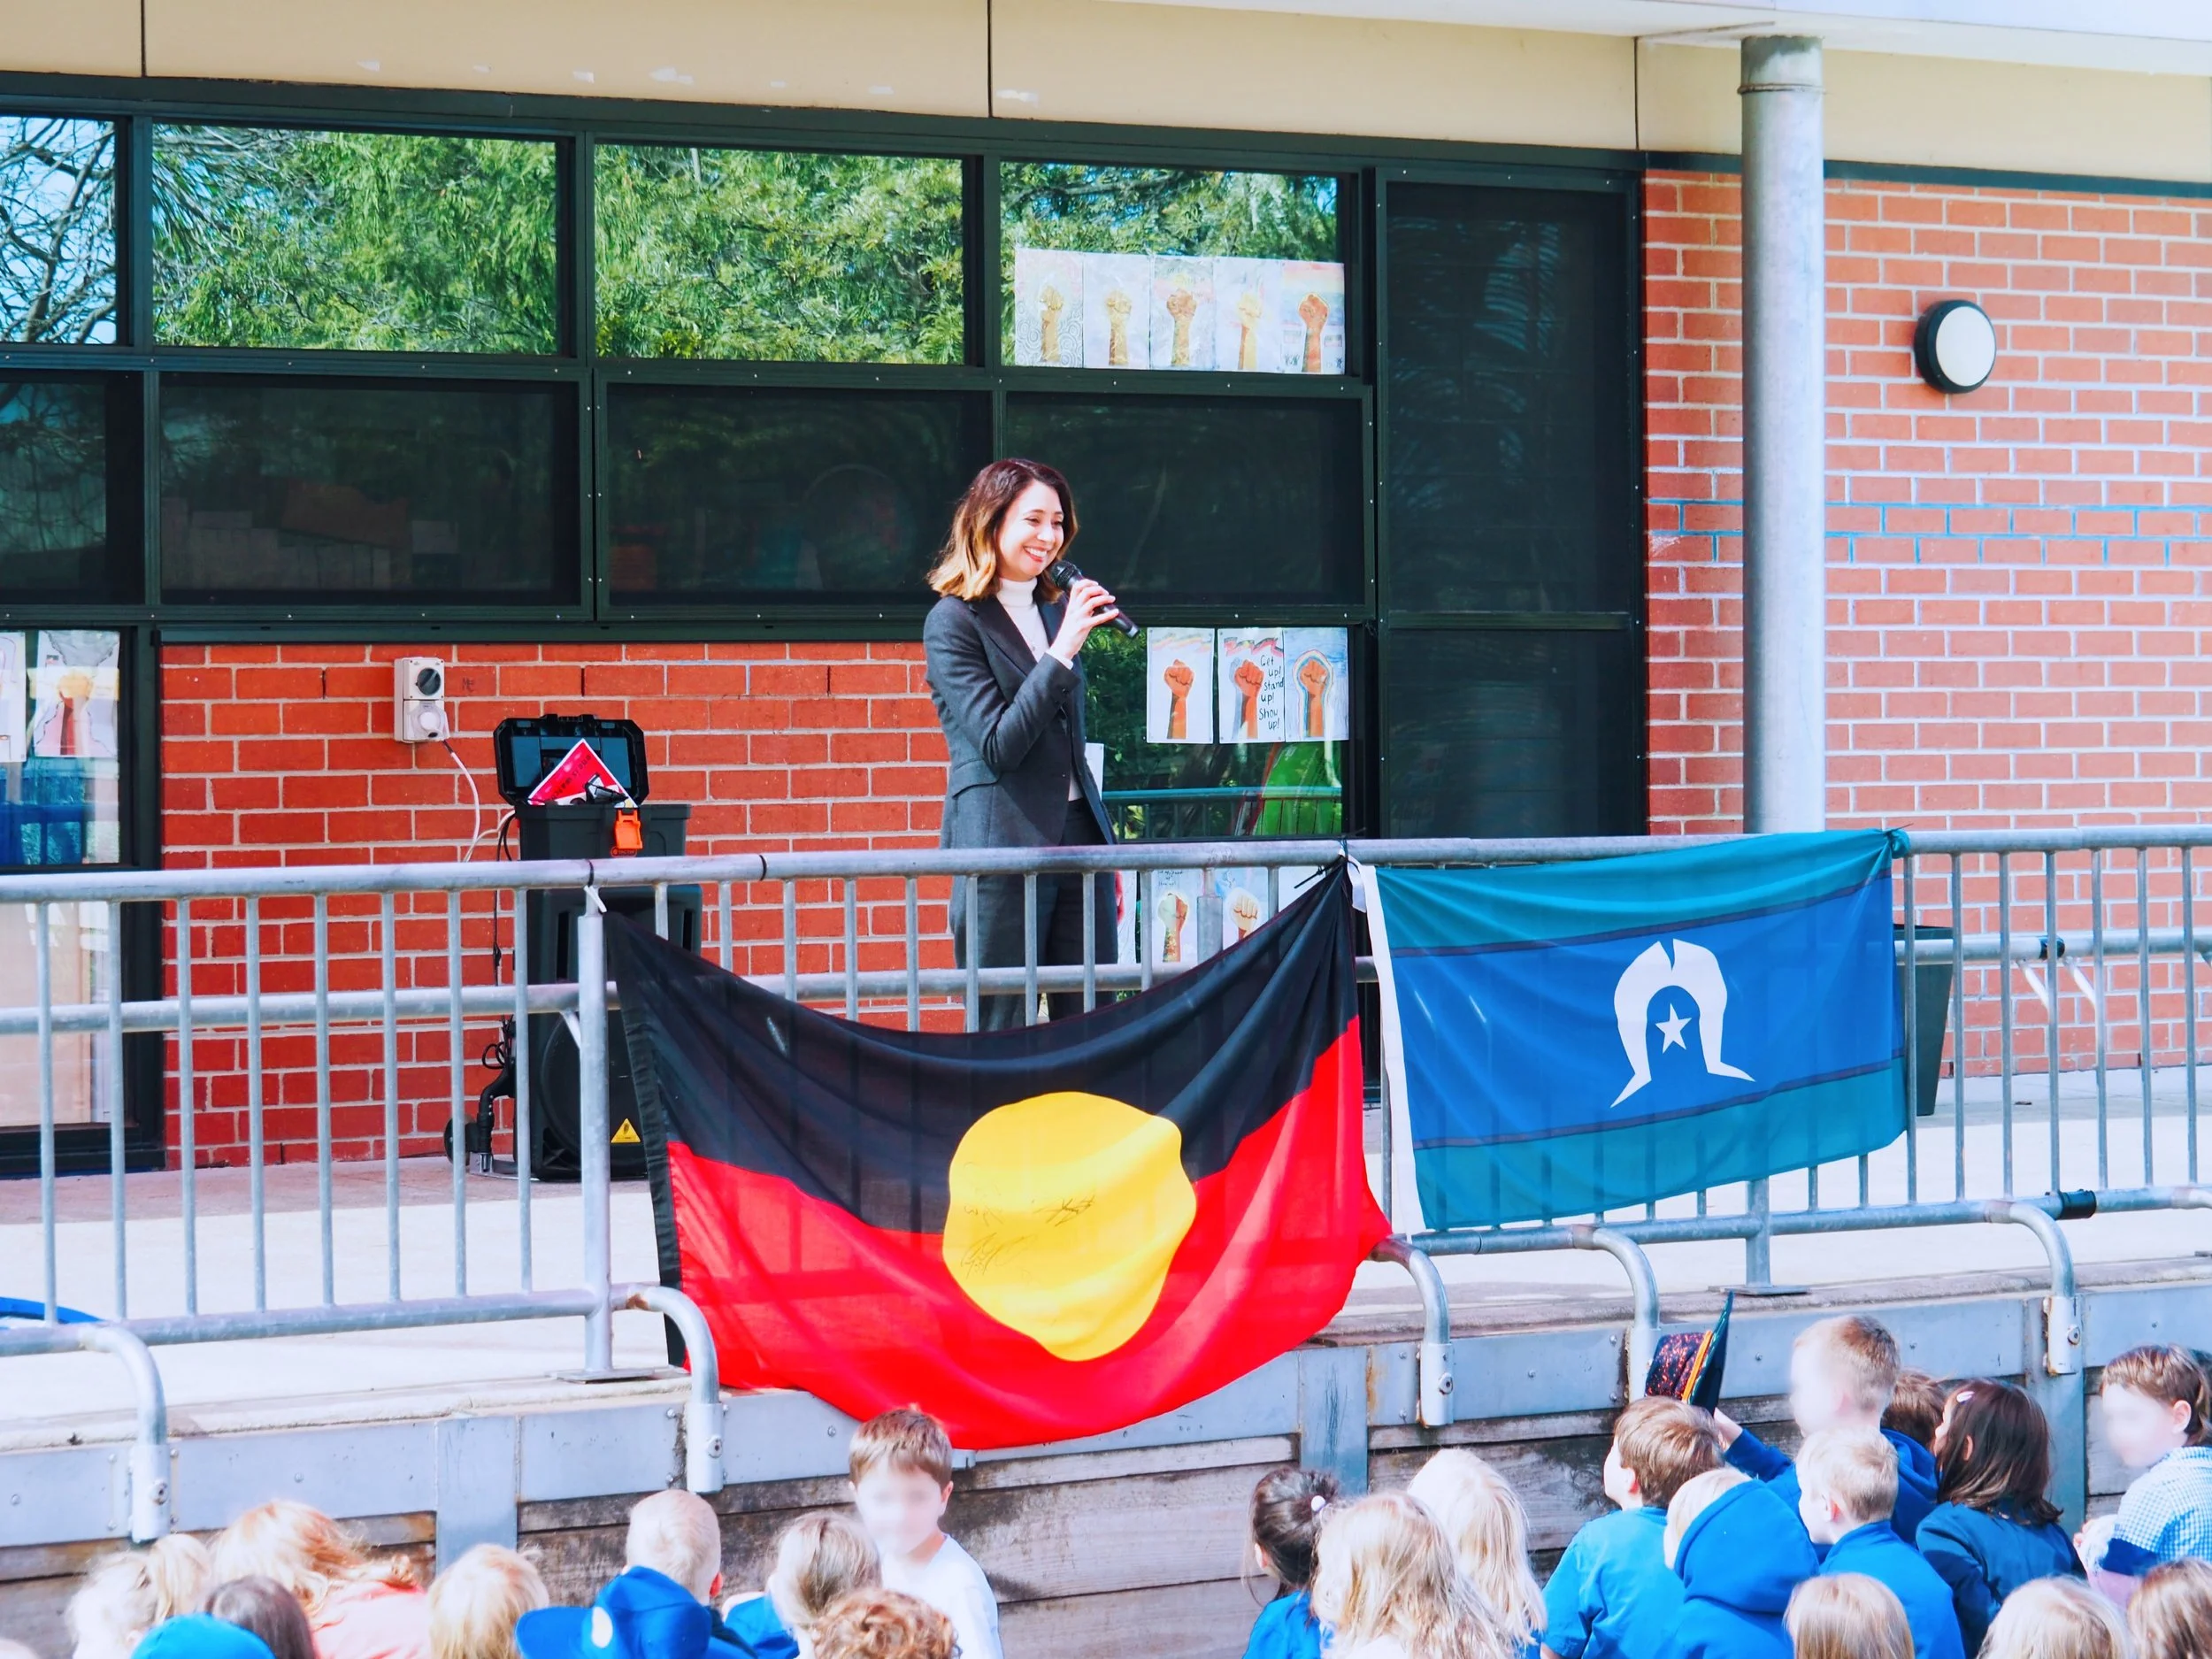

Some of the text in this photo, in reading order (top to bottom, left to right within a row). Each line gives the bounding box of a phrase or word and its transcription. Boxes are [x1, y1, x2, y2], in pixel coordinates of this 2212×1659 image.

[1261, 655, 1274, 666] Get
[1268, 665, 1281, 678] up!
[1268, 718, 1280, 731] up!
